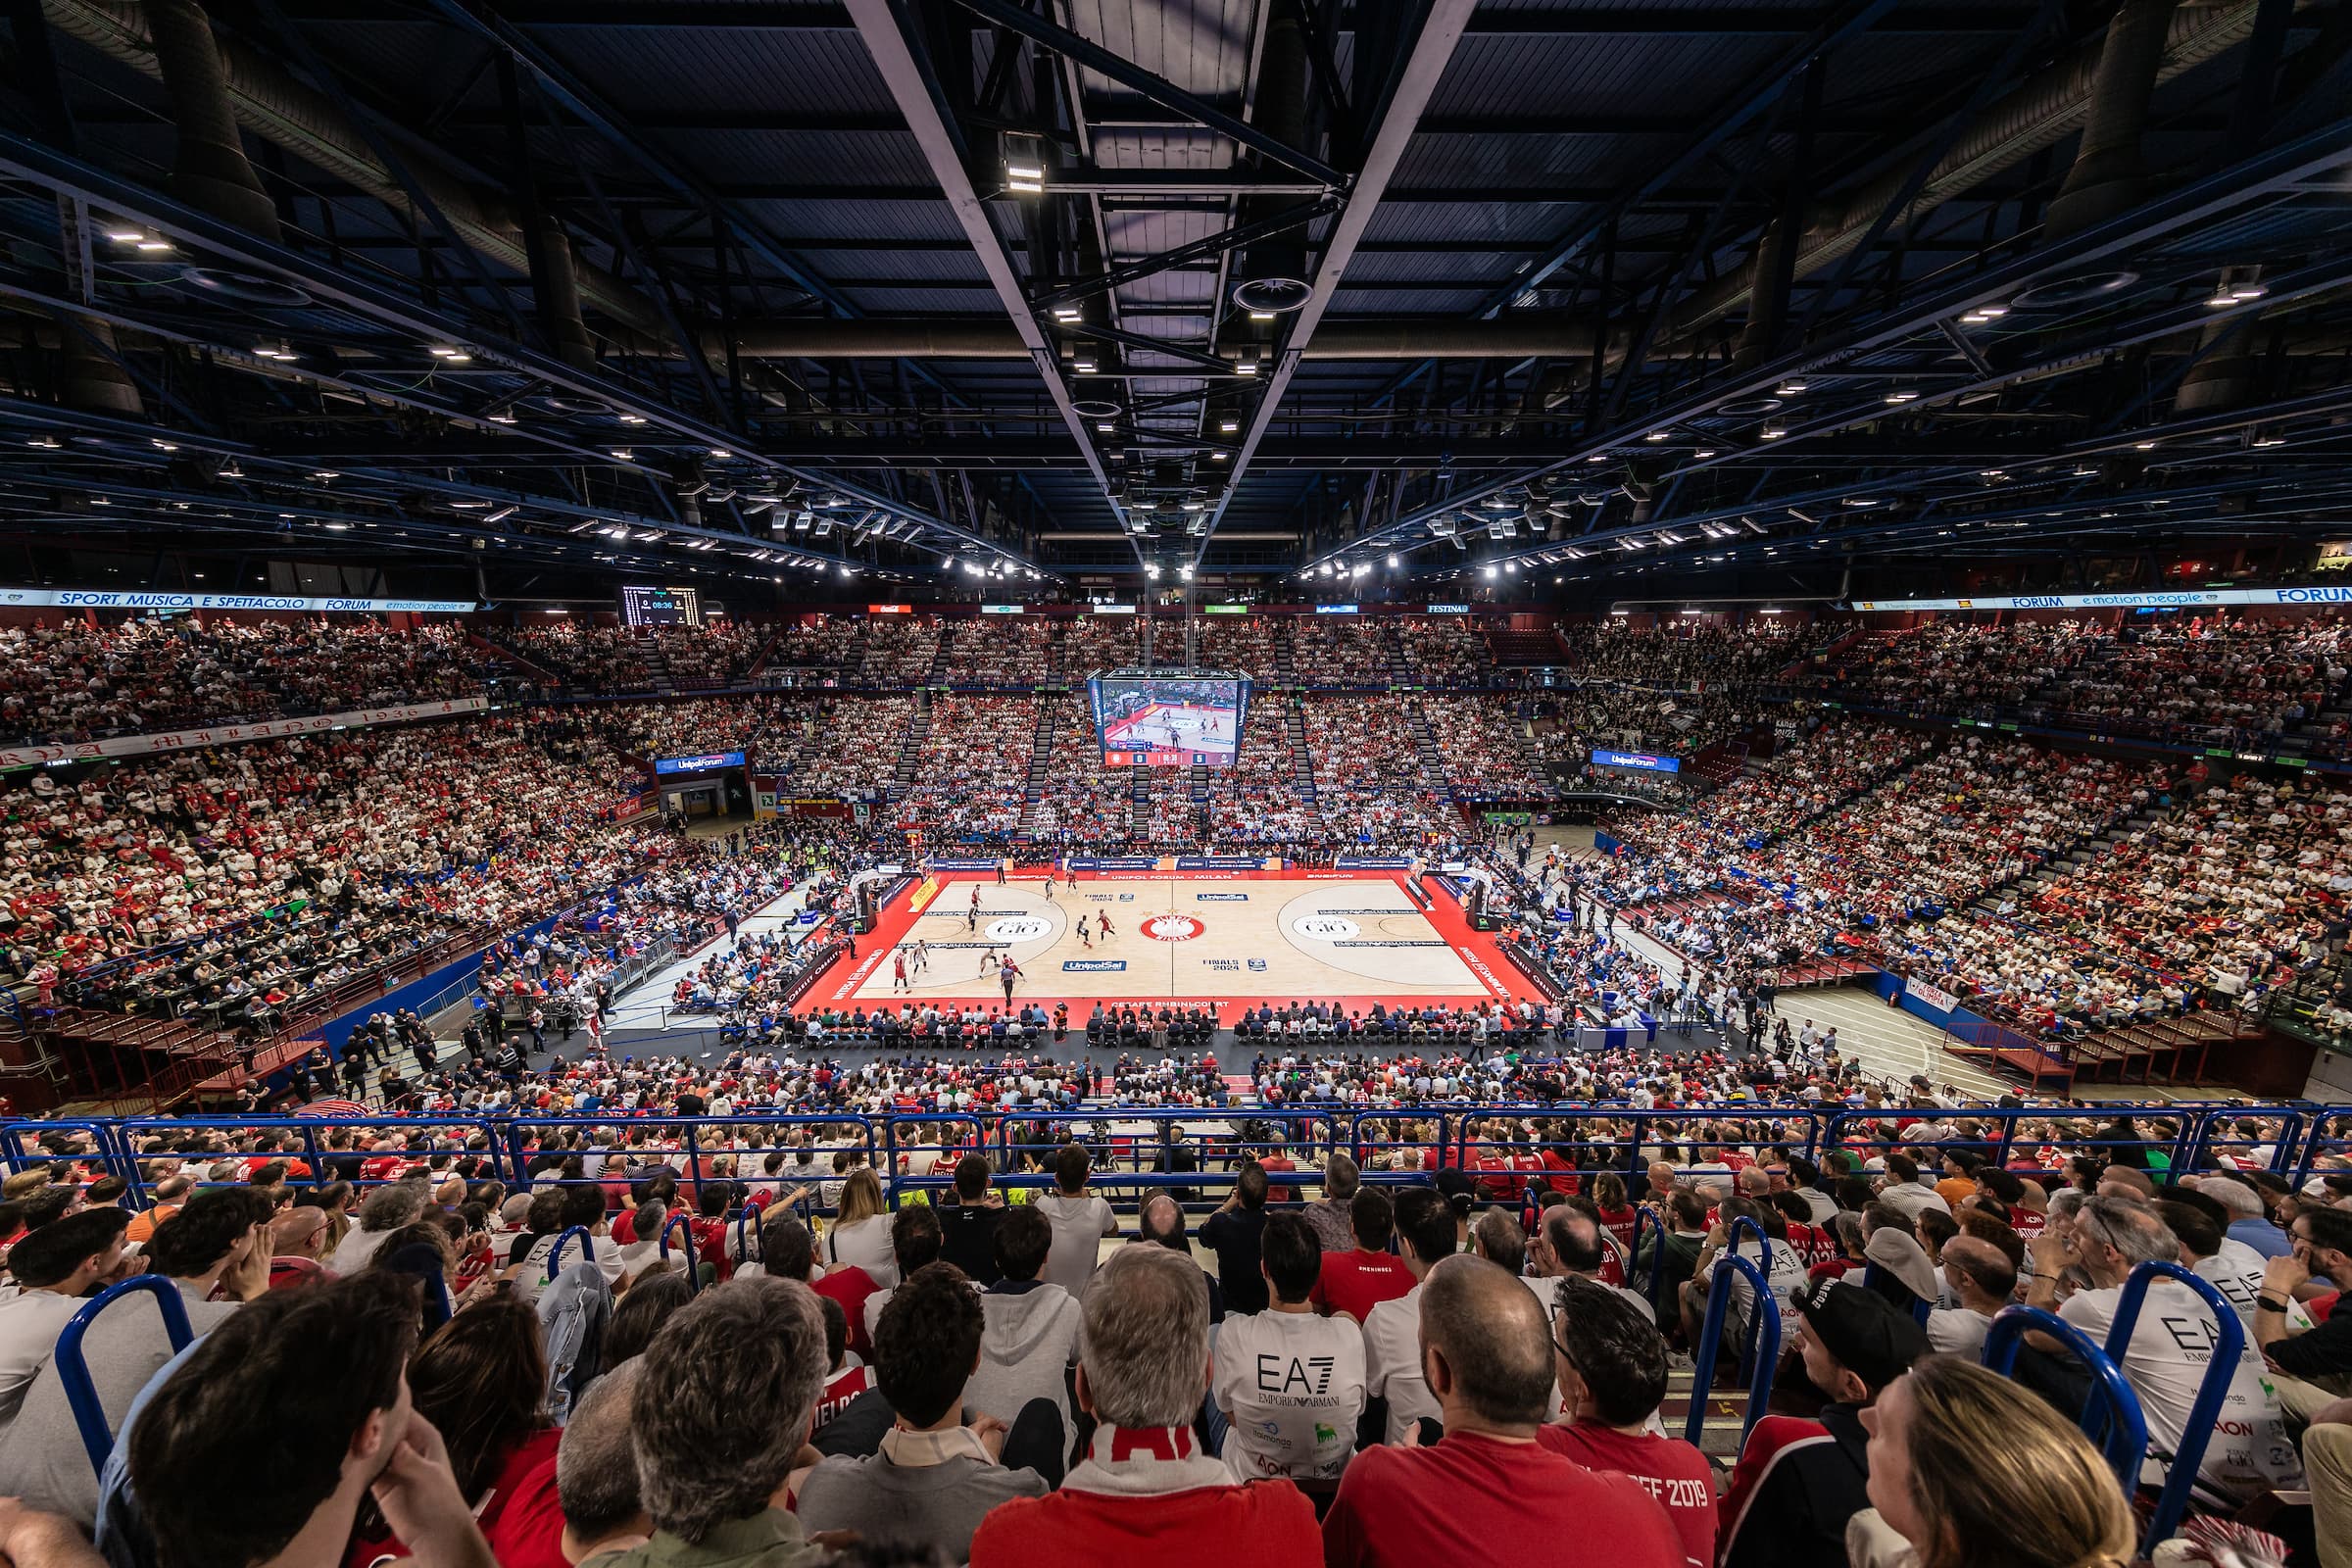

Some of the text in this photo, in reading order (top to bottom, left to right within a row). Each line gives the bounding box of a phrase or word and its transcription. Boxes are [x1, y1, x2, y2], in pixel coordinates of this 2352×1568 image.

[60, 592, 305, 609] SPORT, MUSICA E SPETTACOLO
[325, 600, 372, 610] FORUM
[426, 602, 458, 611] people
[2012, 597, 2065, 608] FORUM
[2146, 593, 2203, 605] people
[150, 718, 332, 751] MILANO
[1918, 990, 1945, 1005] OLIMPIA
[1923, 985, 1942, 998] FORZA
[1257, 1354, 1335, 1395] EA7
[1258, 1394, 1340, 1408] EMPORIO ARMANI
[1257, 1454, 1292, 1477] AON
[1666, 1479, 1708, 1507] 2019
